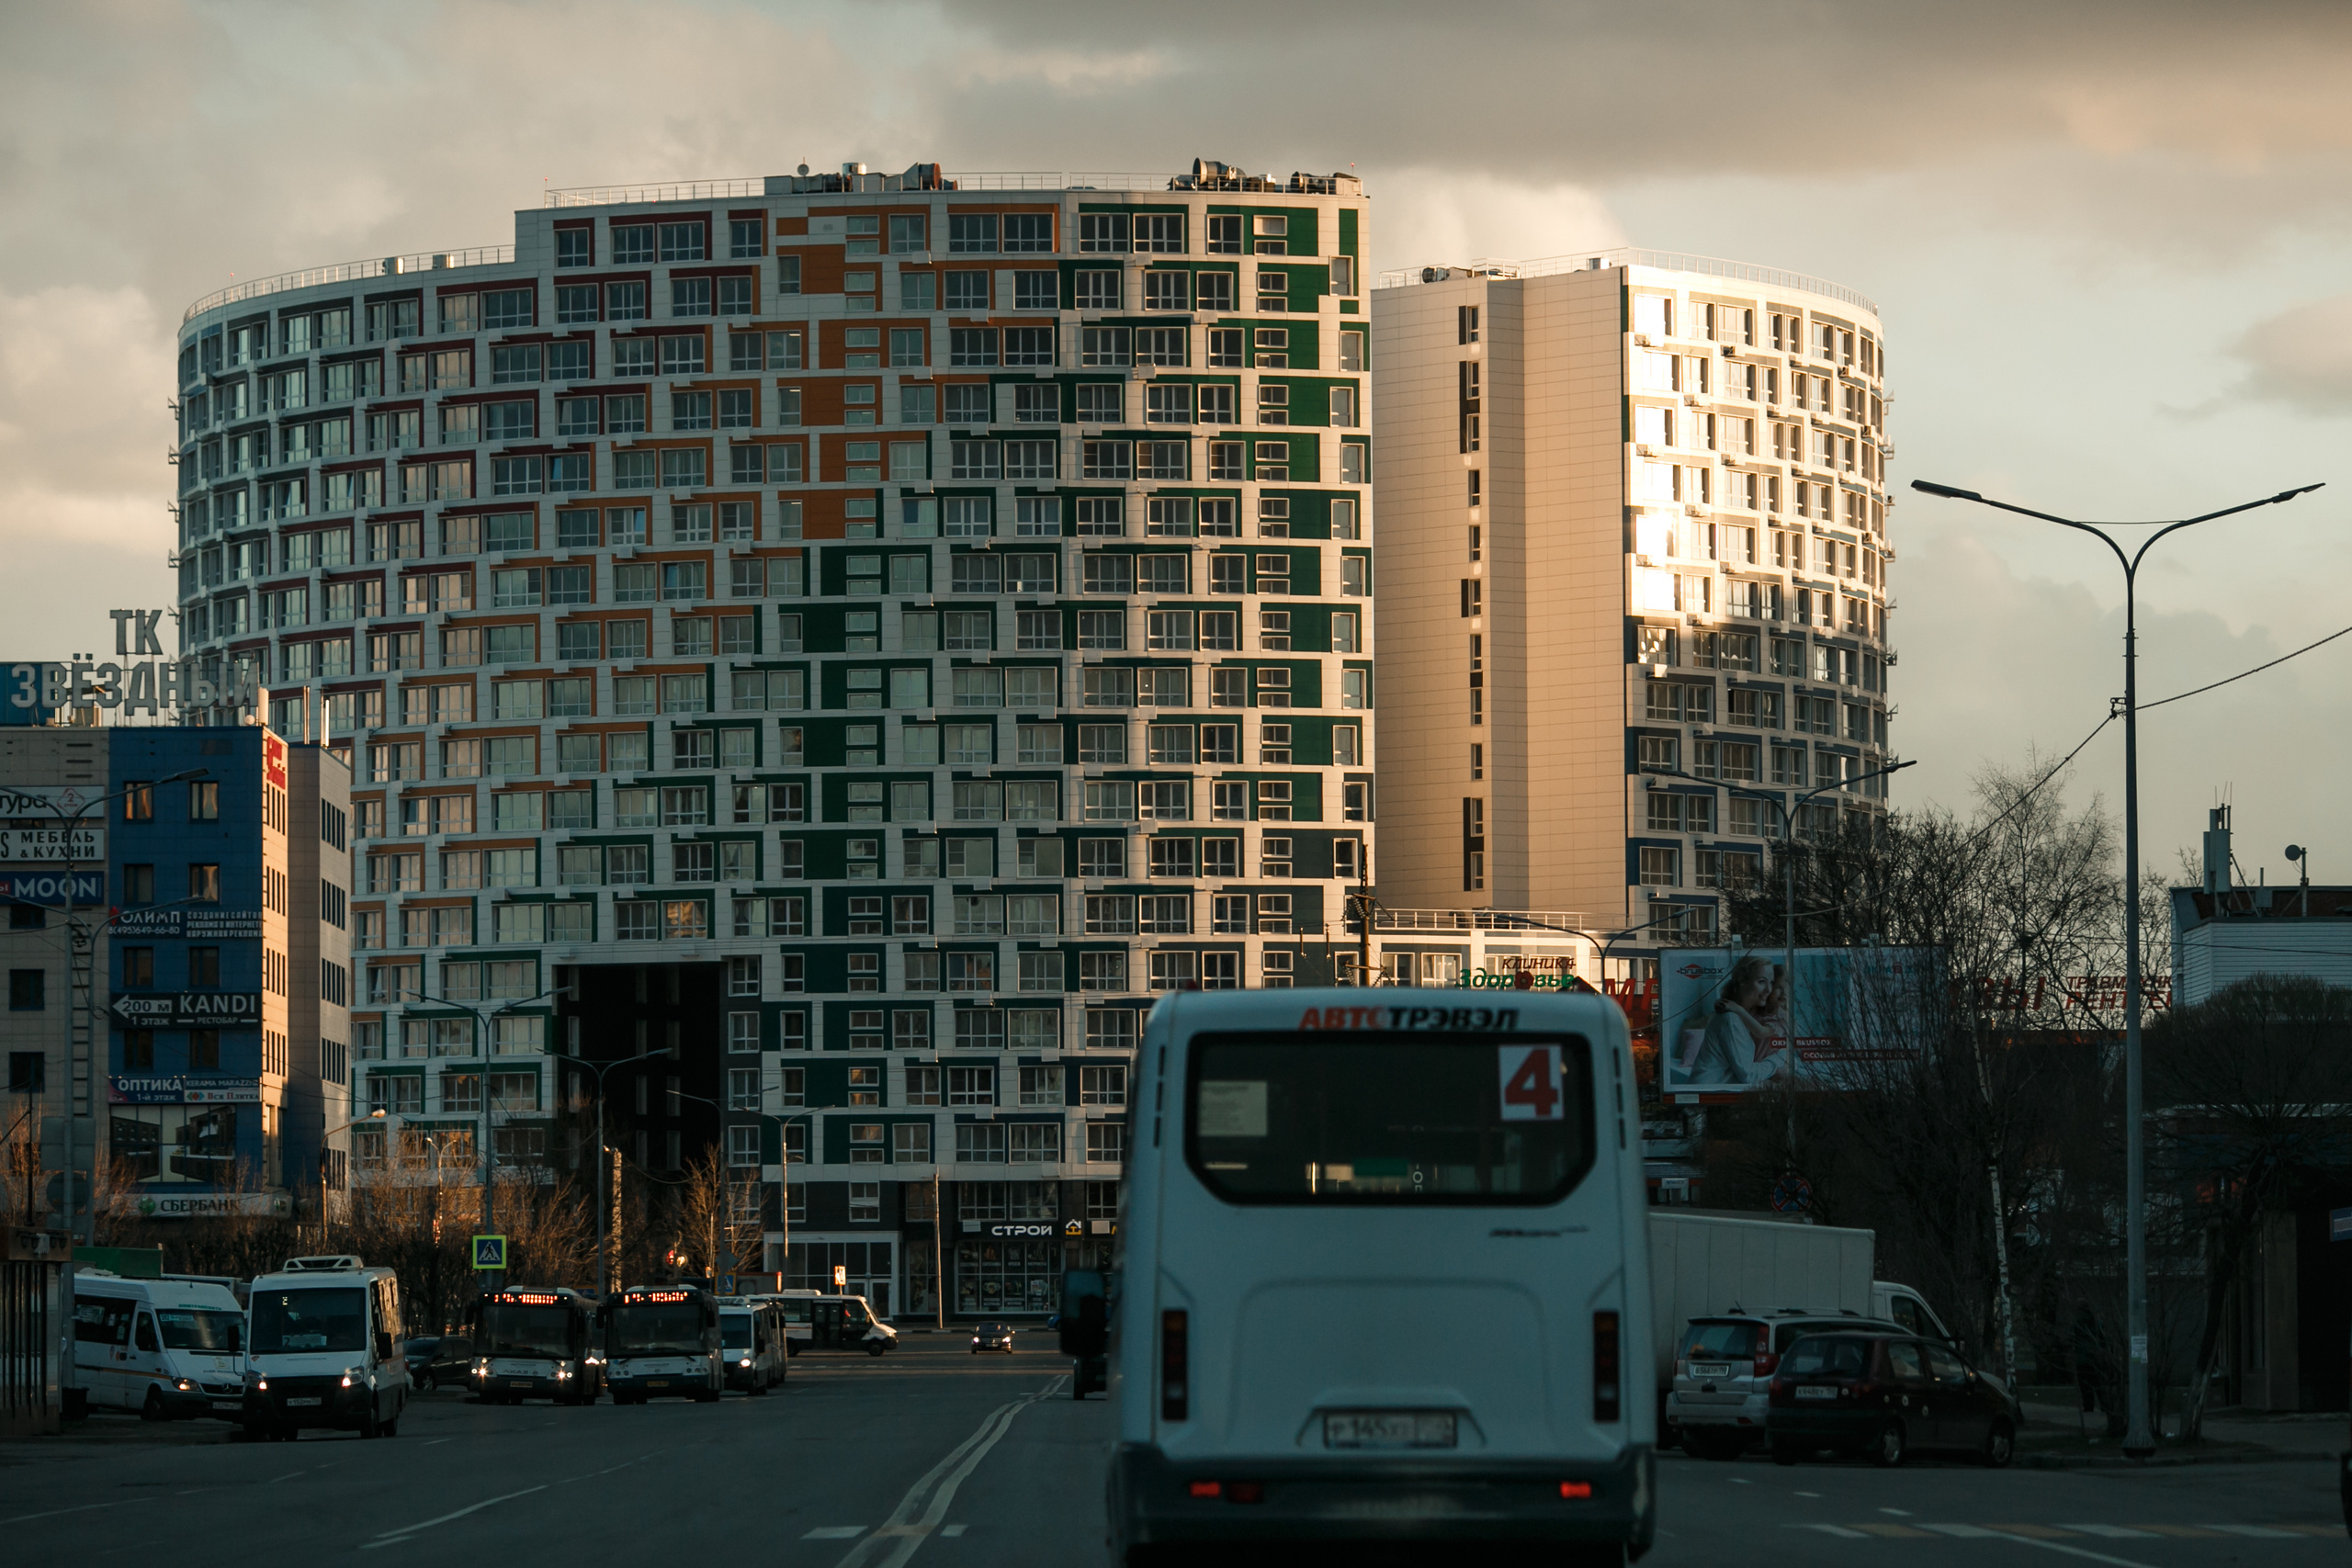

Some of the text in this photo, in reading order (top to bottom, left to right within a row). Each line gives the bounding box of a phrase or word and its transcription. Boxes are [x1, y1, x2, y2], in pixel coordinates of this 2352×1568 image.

[110, 609, 164, 655] ТК
[10, 653, 259, 716] ЗВЁЗДНЫЙ
[20, 831, 95, 843] МЕБЕЛЬ
[20, 846, 95, 858] & КУХНИ
[15, 877, 96, 898] MOON
[120, 910, 180, 924] ОЛИМП
[1679, 966, 1724, 975] brusbox
[122, 1001, 152, 1012] 200
[179, 995, 255, 1013] KANDI
[131, 1017, 137, 1025] 1
[118, 1078, 183, 1091] ОПТИКА
[1504, 1049, 1558, 1116] 4
[161, 1200, 241, 1212] СБЕРБАНК
[990, 1224, 1054, 1236] СТРОЙ
